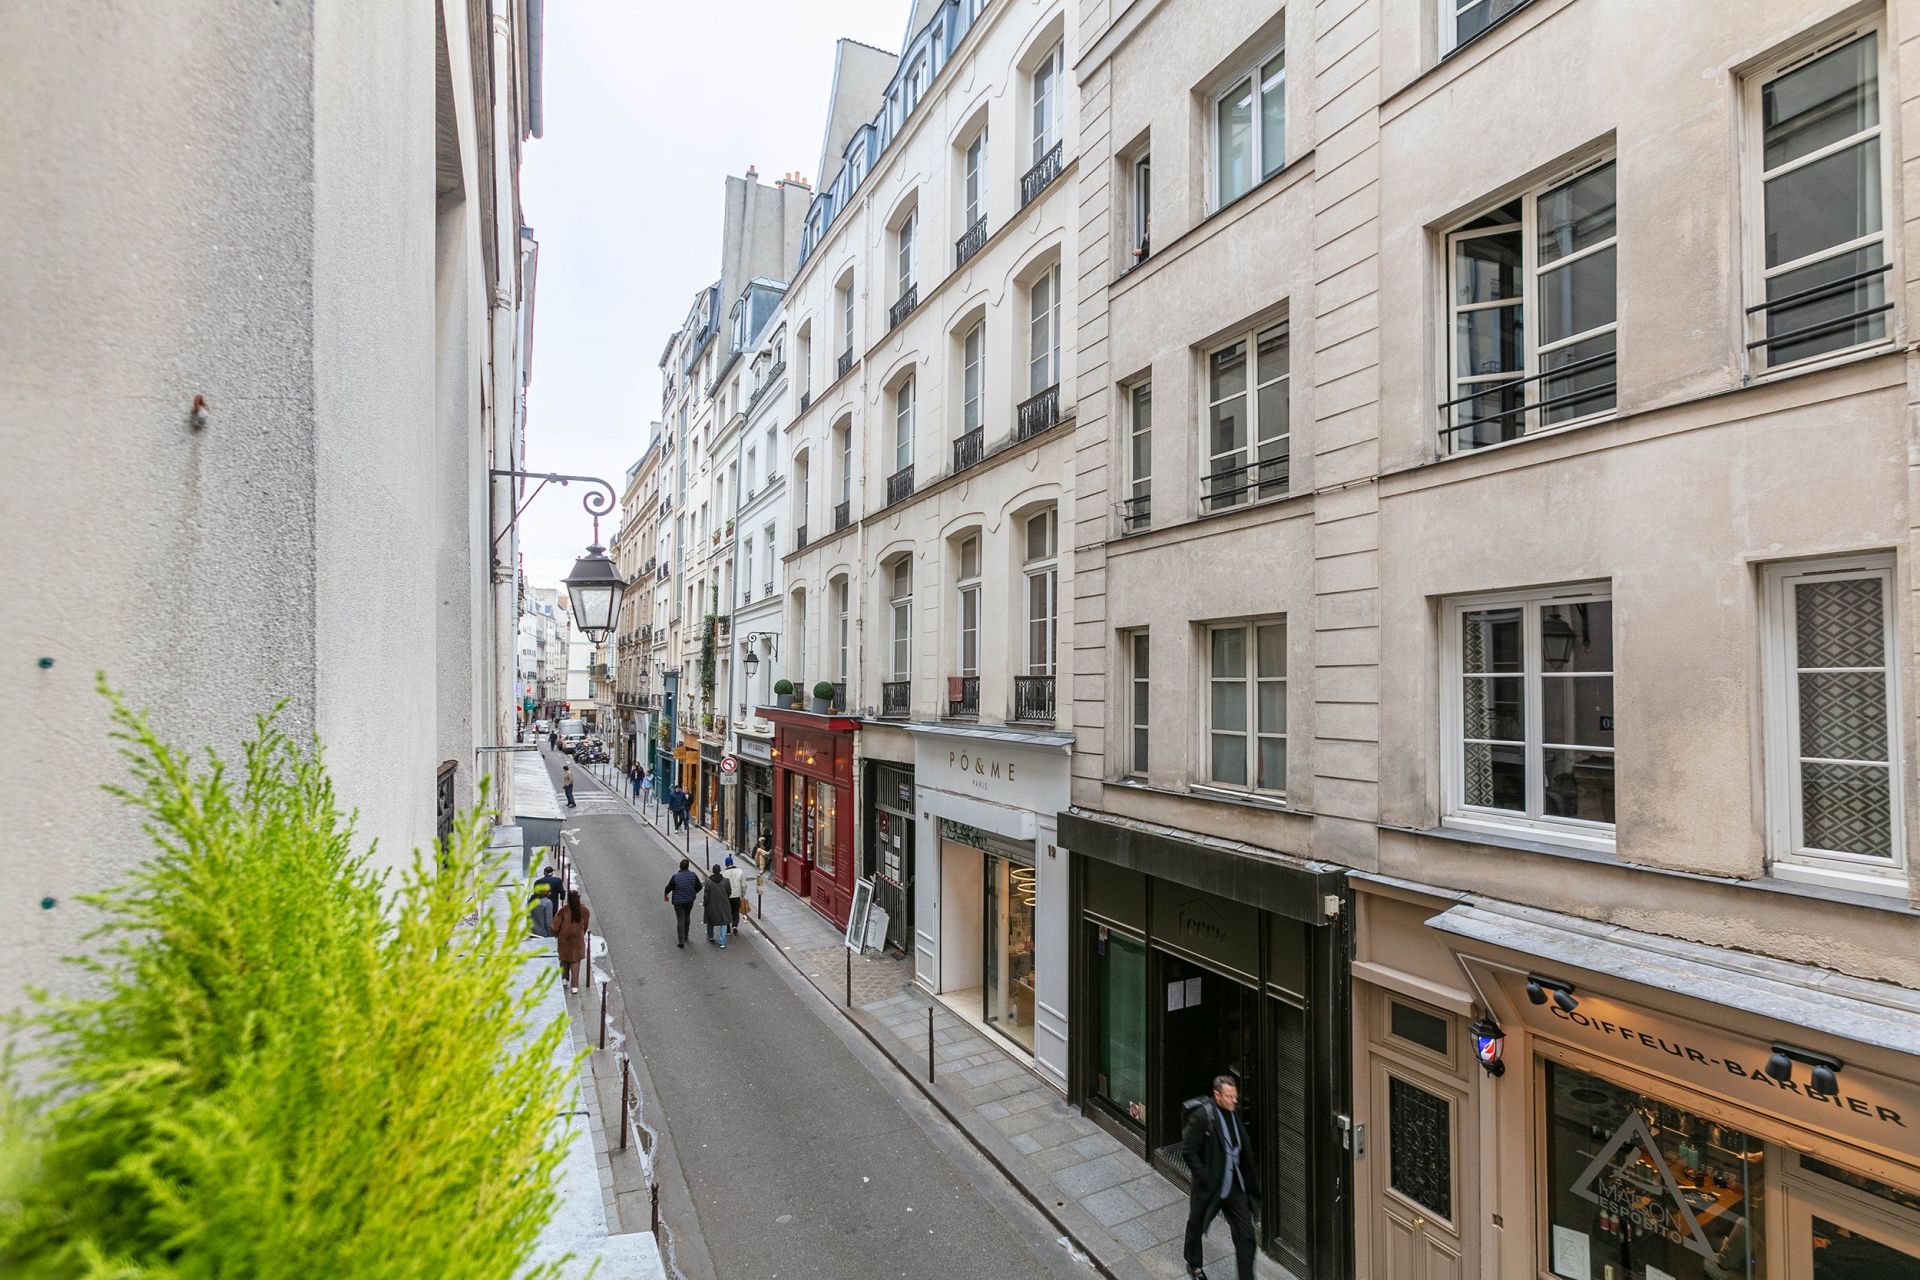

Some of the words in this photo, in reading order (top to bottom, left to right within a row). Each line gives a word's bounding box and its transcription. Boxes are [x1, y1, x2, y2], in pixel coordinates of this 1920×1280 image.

[972, 779, 988, 790] PARIS
[1550, 1005, 1908, 1128] COIFFEUR-BARBIER
[1600, 1197, 1682, 1244] ESPOSITO
